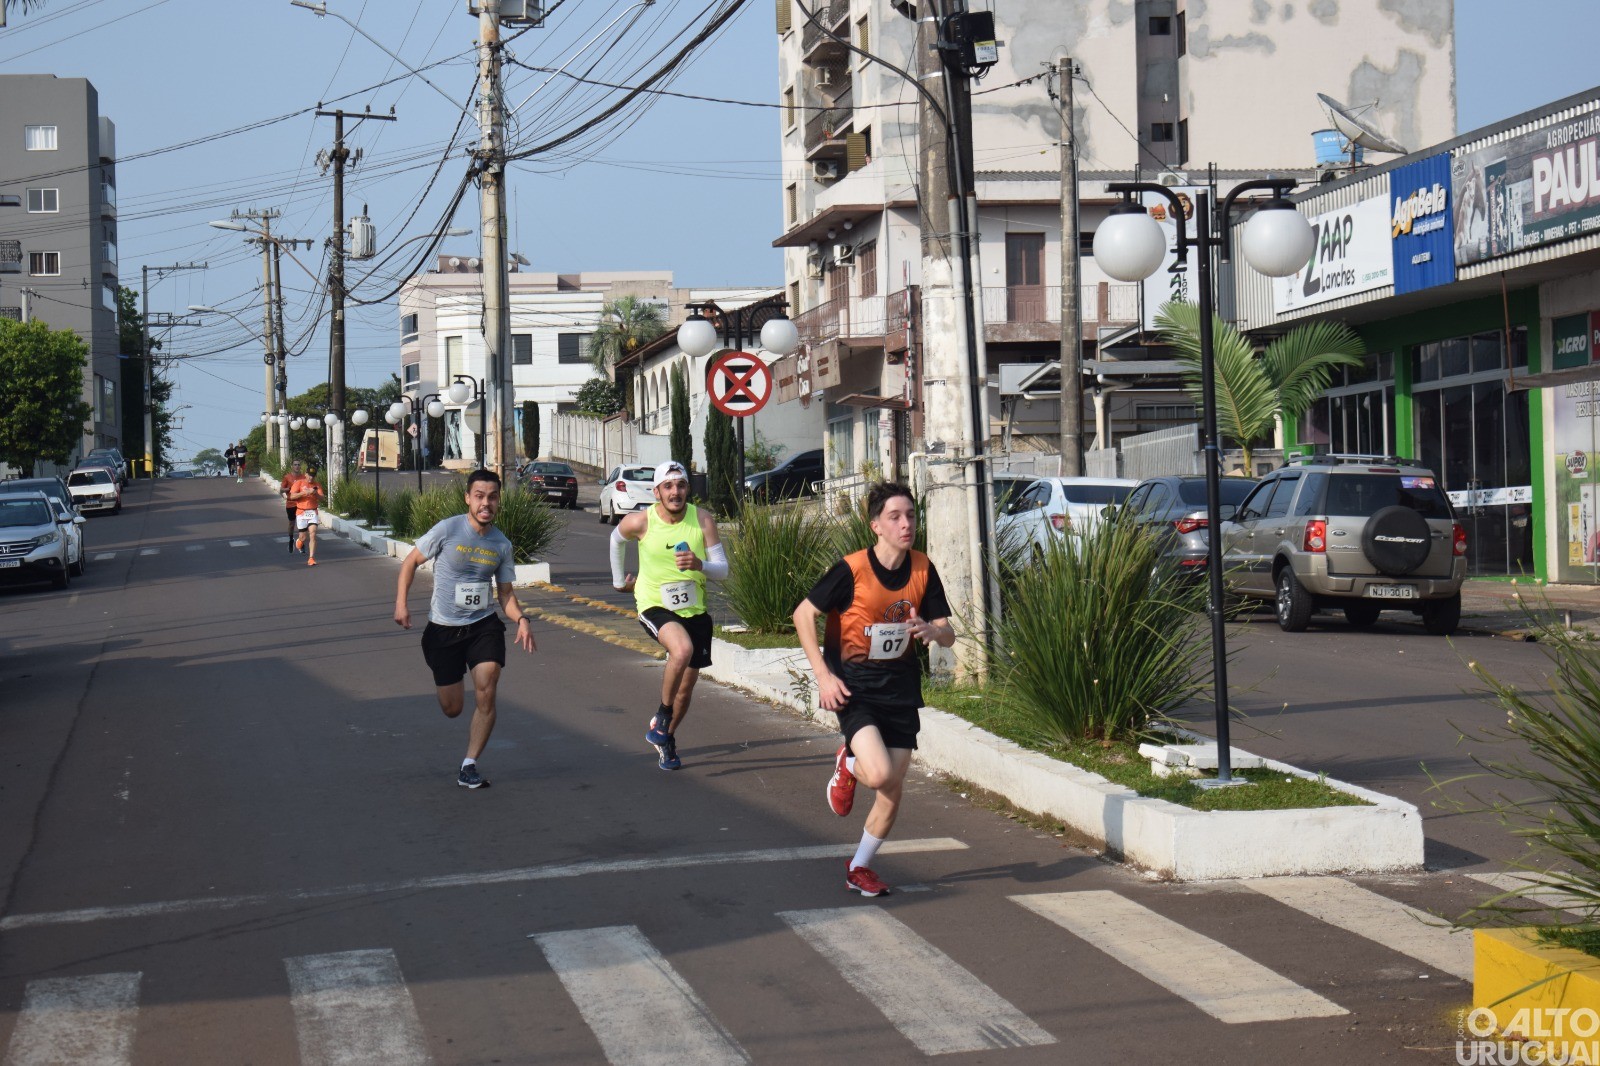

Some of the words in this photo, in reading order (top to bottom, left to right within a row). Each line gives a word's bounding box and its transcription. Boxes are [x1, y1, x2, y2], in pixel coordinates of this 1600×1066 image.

[1392, 183, 1446, 231] AgroBella
[1569, 221, 1577, 234] PET
[1322, 264, 1355, 293] Lanches
[1558, 335, 1586, 354] AGRO
[465, 595, 481, 605] 58
[672, 593, 689, 605] 33
[883, 638, 903, 652] 07
